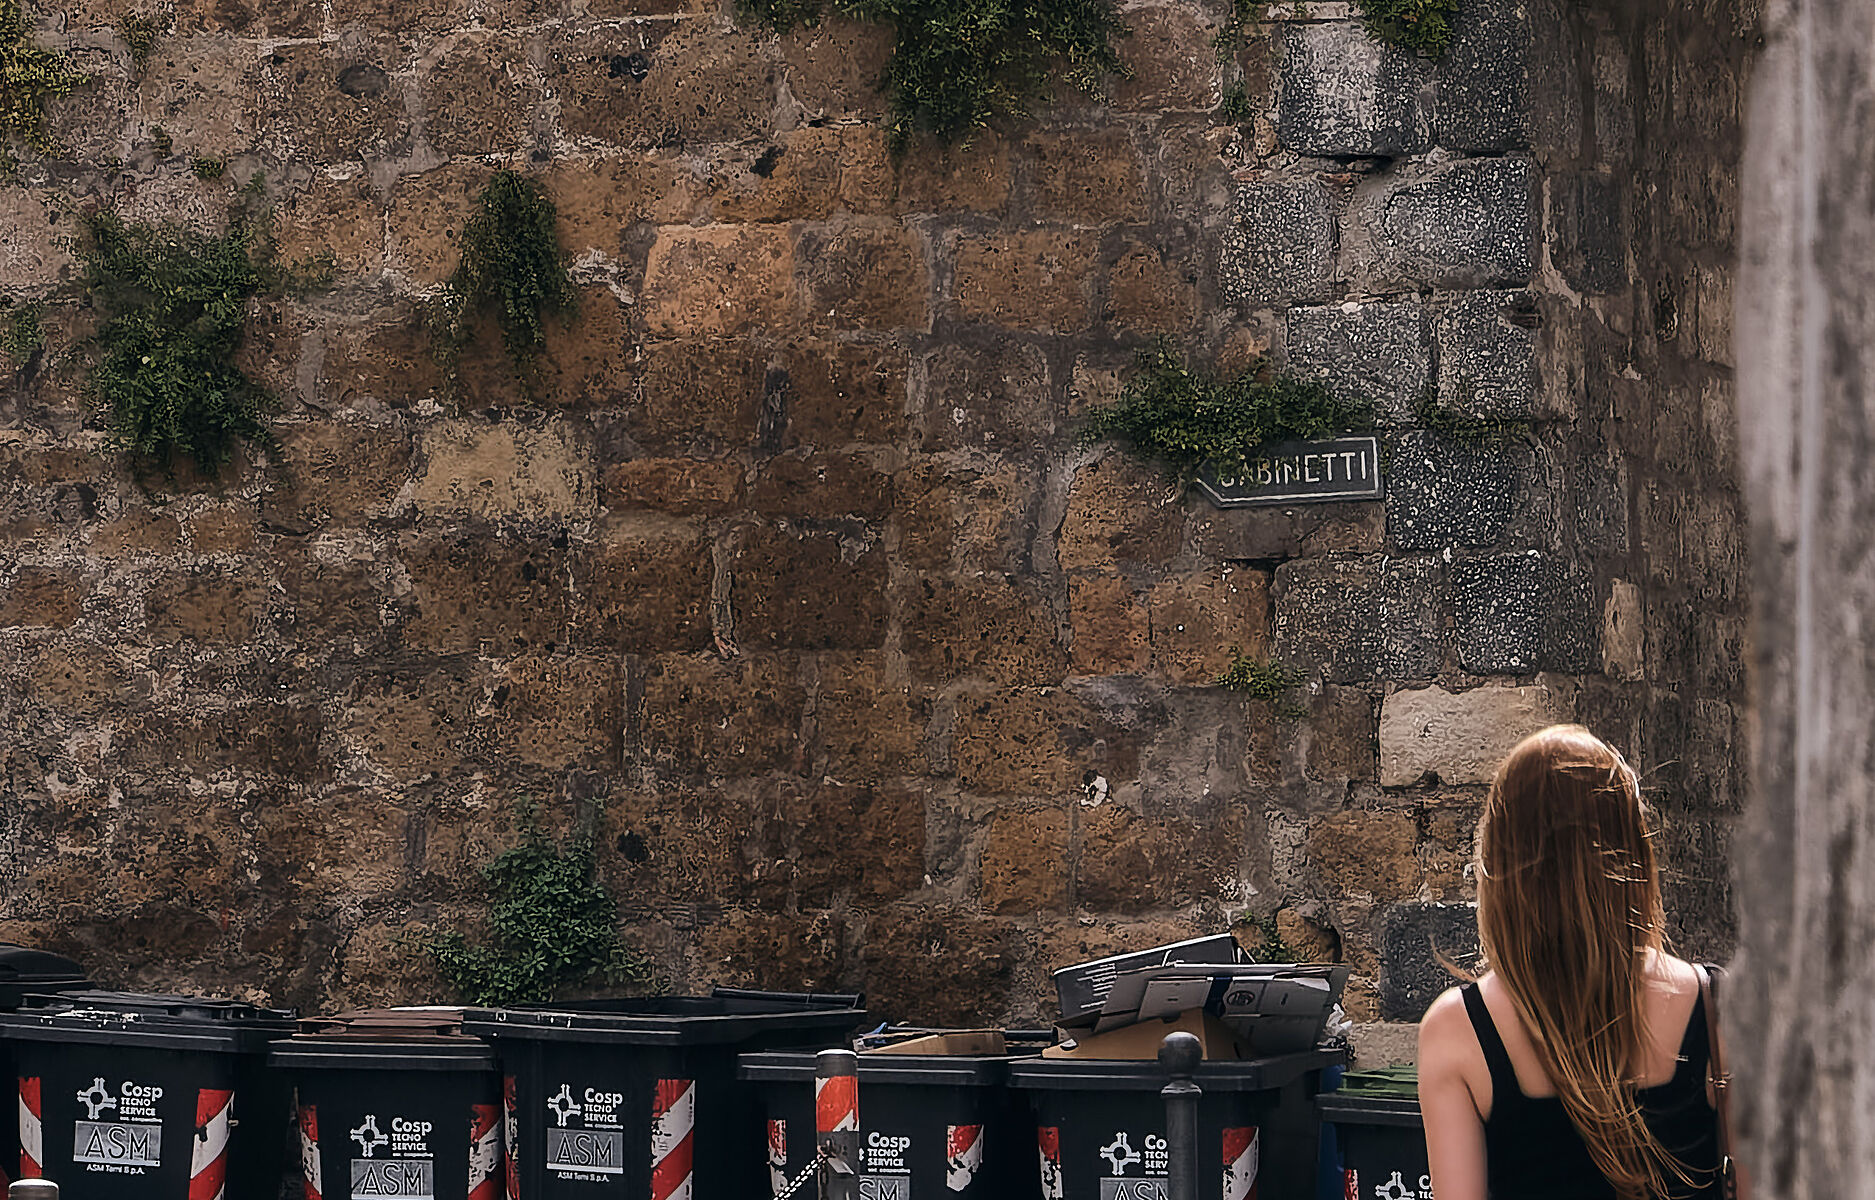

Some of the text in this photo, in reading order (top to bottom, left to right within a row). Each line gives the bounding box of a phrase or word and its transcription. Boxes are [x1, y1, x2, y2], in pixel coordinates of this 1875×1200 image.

[121, 1081, 163, 1102] Cosp
[120, 1097, 151, 1107] TECNO
[584, 1087, 623, 1108] Cosp
[119, 1106, 156, 1116] SERVICE
[584, 1103, 613, 1113] TECNO
[584, 1113, 618, 1123] SERVICE
[391, 1117, 433, 1136] Cosp
[391, 1133, 422, 1142] TECNO
[867, 1131, 911, 1152] Cosp
[1144, 1134, 1168, 1150] Co
[83, 1125, 151, 1161] ASM
[391, 1142, 427, 1151] SERVICE
[554, 1131, 614, 1167] ASM
[867, 1148, 899, 1157] TECNO
[1144, 1150, 1169, 1159] TECN
[867, 1158, 904, 1167] SERVICE
[1144, 1160, 1168, 1169] SERV
[360, 1162, 424, 1197] ASM
